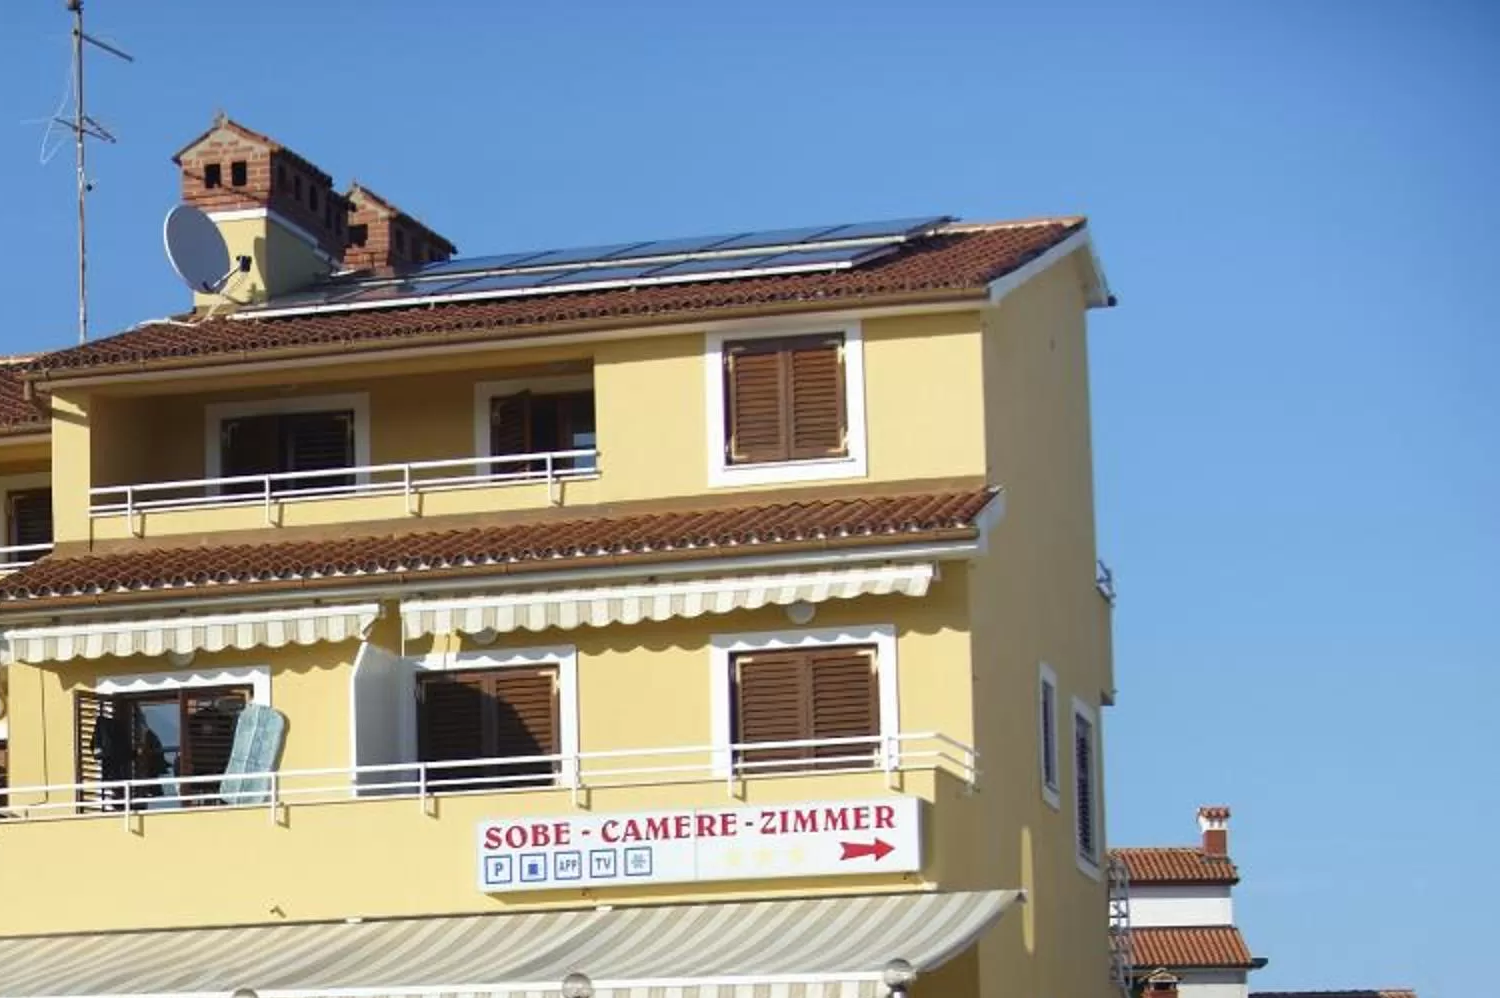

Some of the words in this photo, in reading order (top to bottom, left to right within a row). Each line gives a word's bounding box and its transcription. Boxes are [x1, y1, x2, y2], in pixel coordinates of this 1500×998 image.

[484, 822, 571, 850] SOBE
[601, 813, 737, 843] CAMERE
[760, 805, 896, 834] ZIMMER
[595, 857, 611, 870] TV
